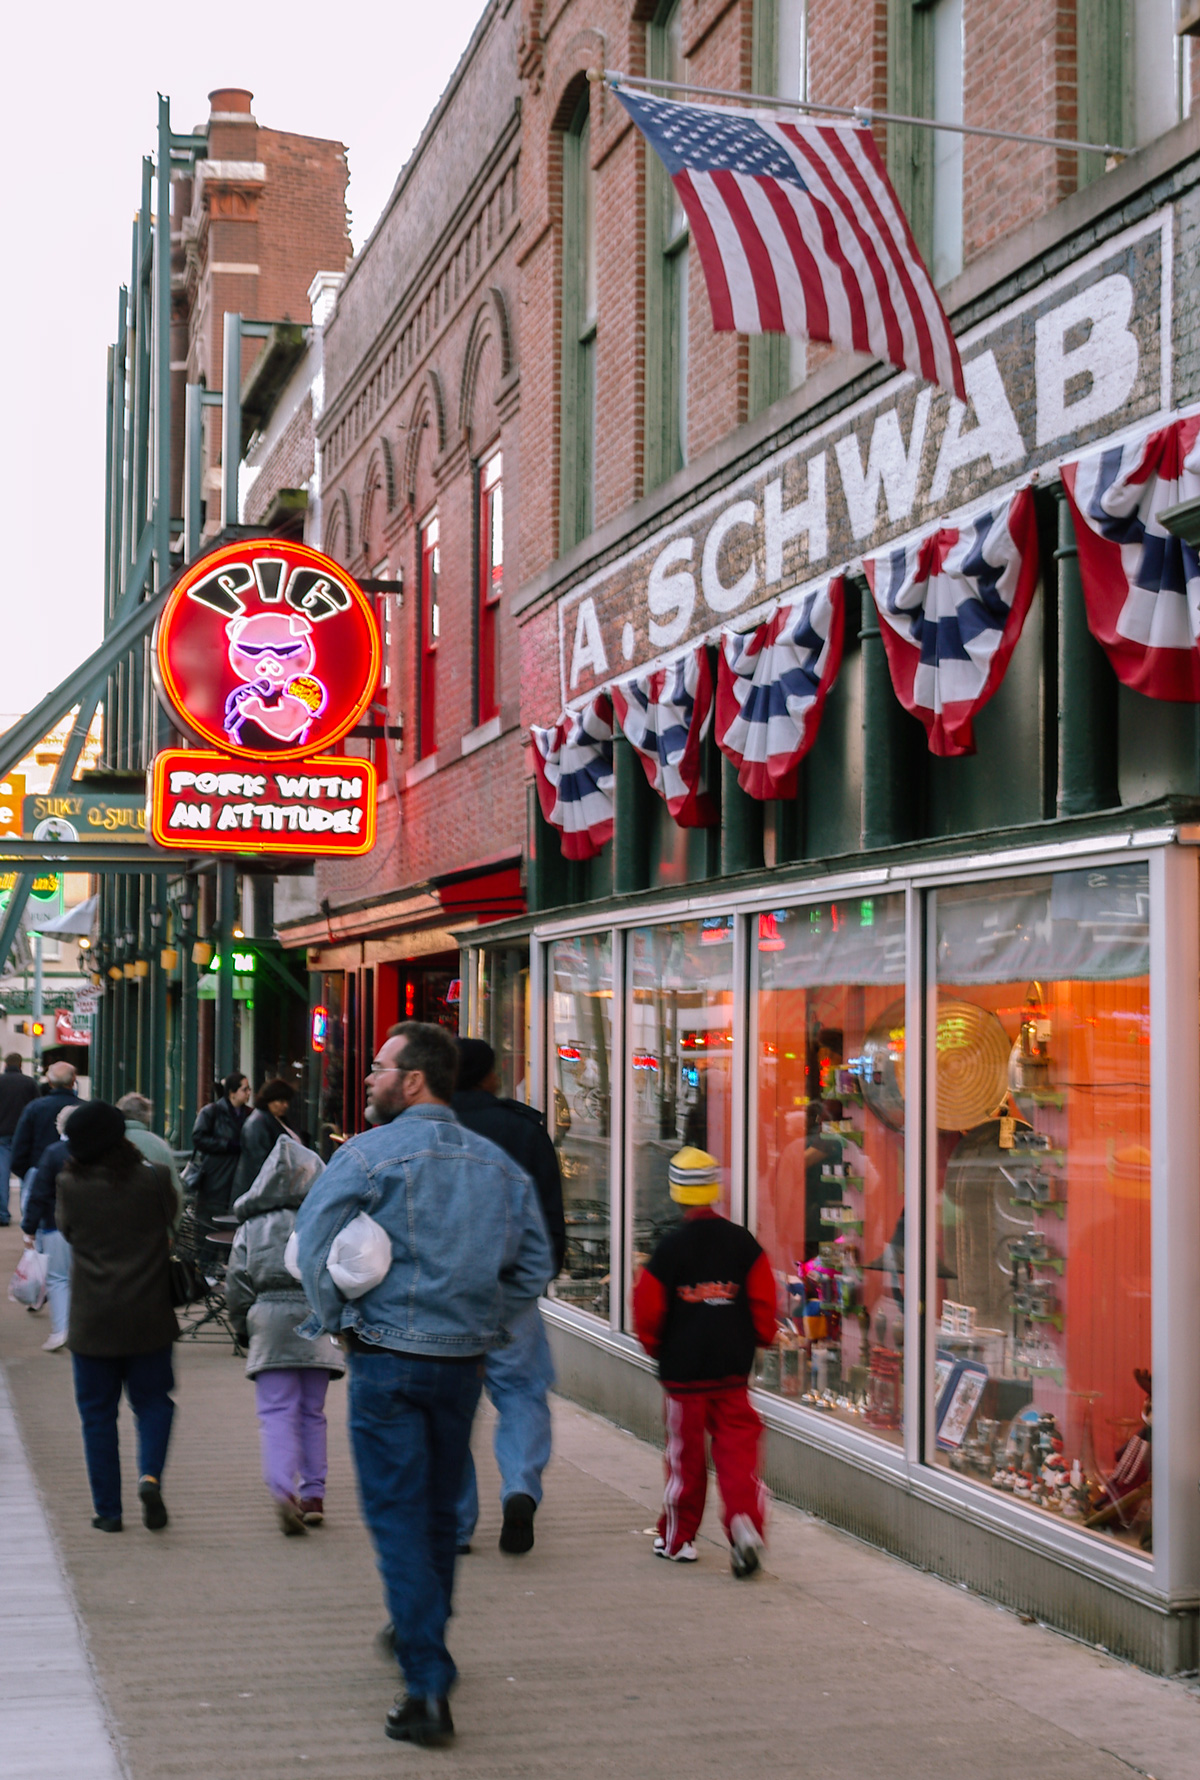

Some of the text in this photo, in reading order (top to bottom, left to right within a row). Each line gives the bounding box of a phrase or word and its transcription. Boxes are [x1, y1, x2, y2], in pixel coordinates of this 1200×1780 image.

[647, 272, 1140, 648] SCHWAB
[187, 557, 352, 623] PIG
[169, 771, 363, 799] PORK WITH
[169, 802, 363, 834] AN ATTITUDE!
[73, 1014, 89, 1025] ATM
